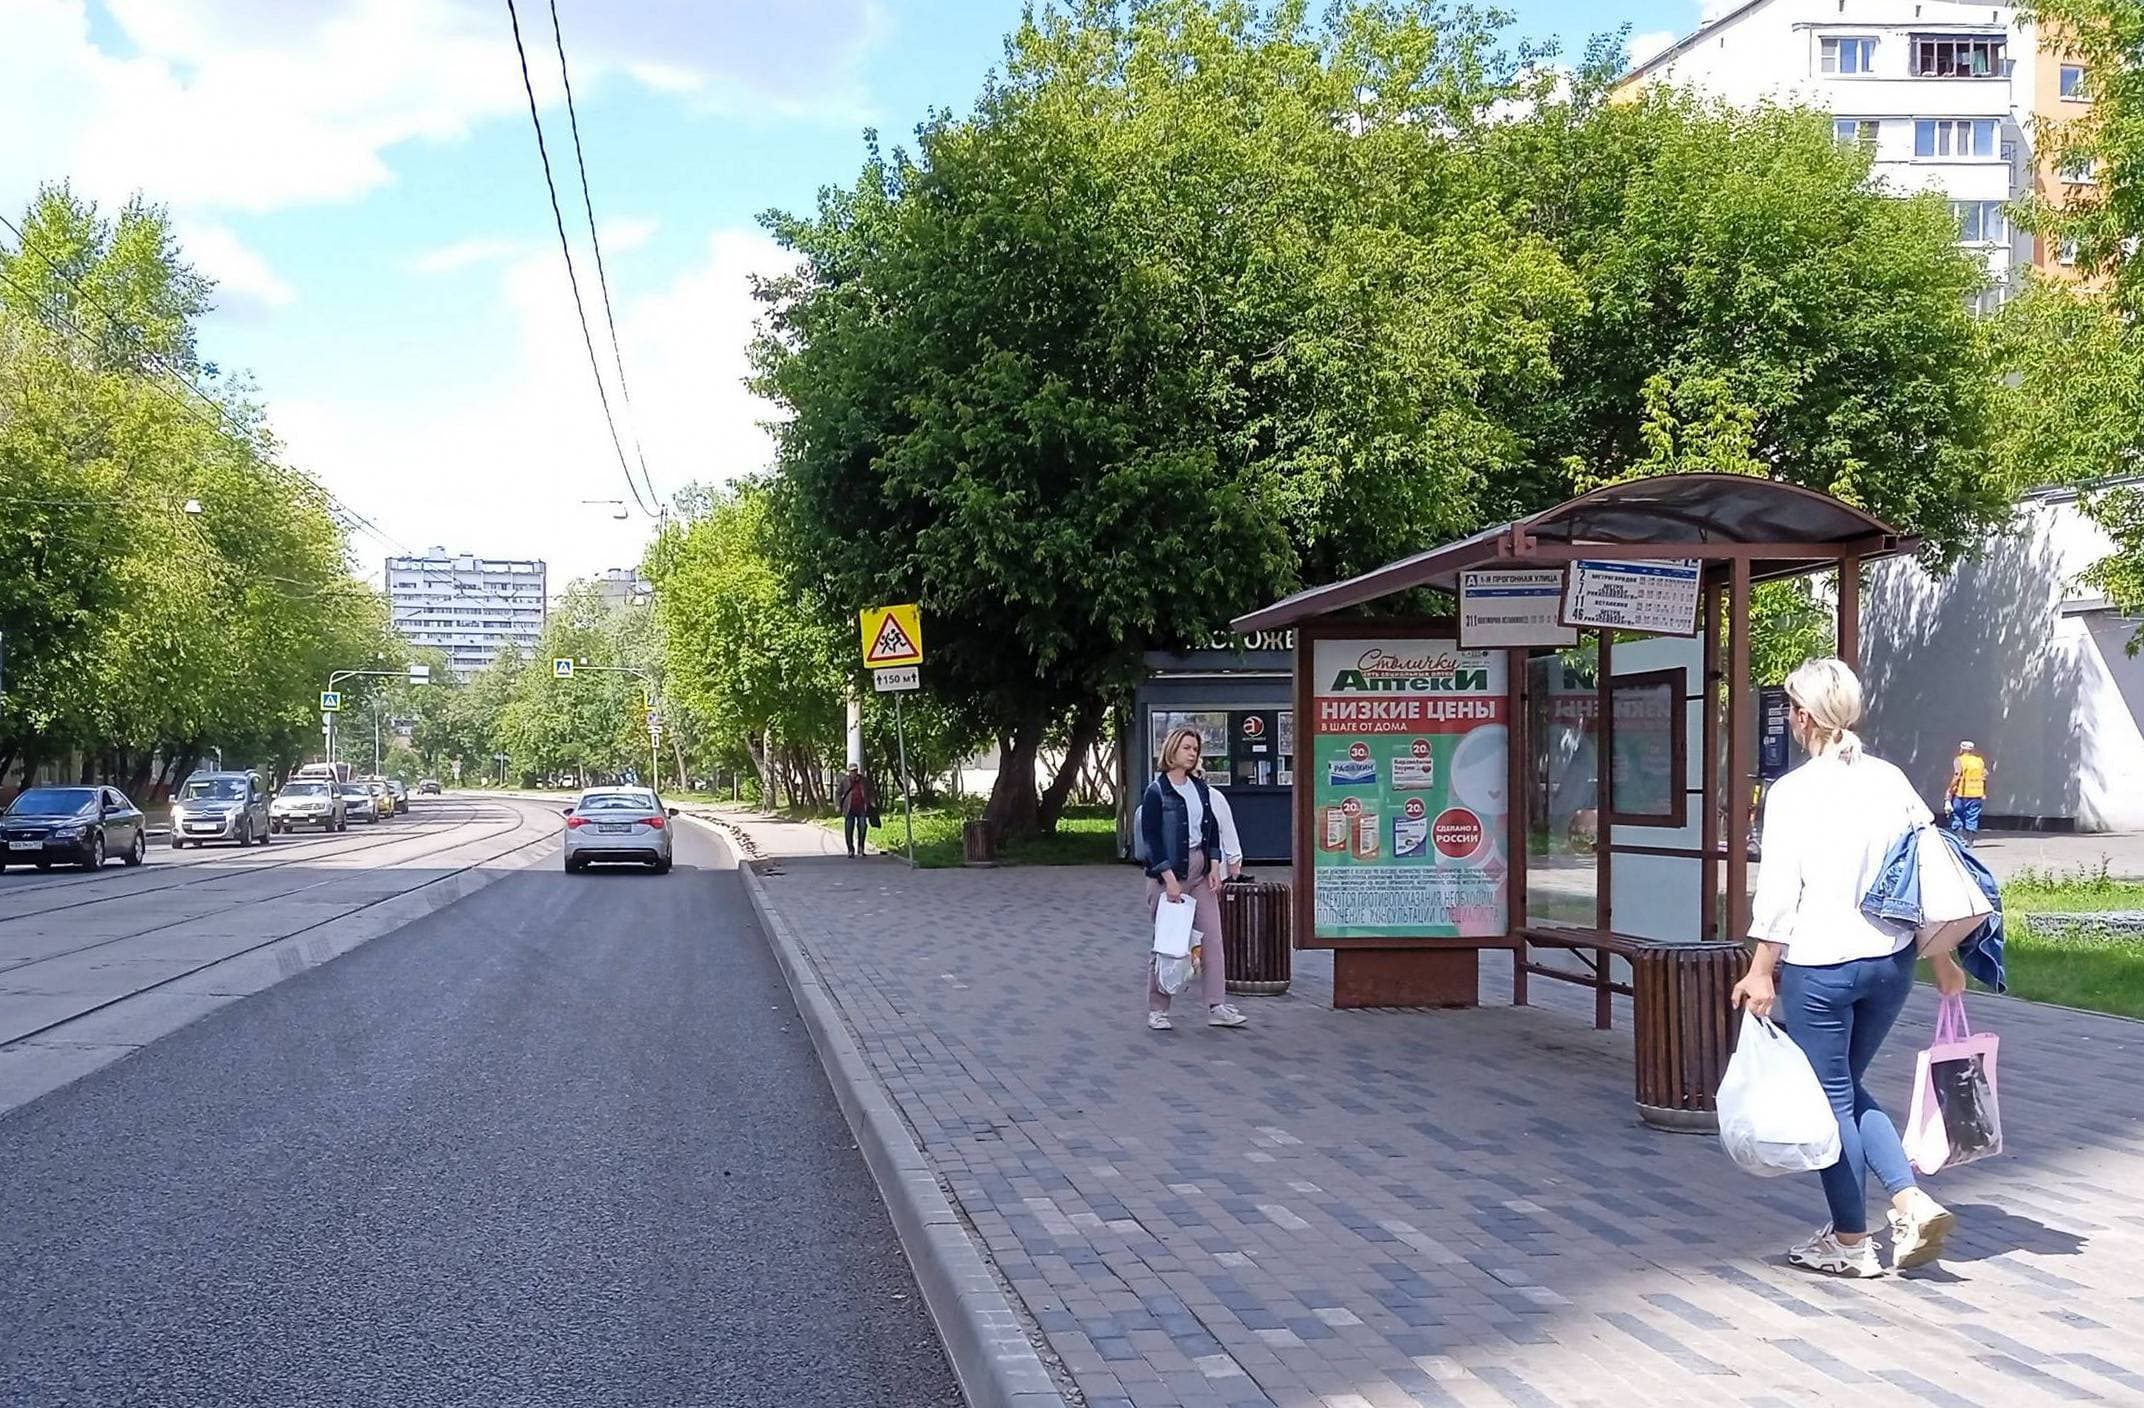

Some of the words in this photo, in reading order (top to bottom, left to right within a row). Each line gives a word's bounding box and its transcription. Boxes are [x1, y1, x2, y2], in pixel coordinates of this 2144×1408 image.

[1492, 574, 1533, 584] ПРОГОННАЯ
[1535, 574, 1558, 583] УЛИЦА
[1579, 569, 1586, 581] 2
[1578, 582, 1585, 594] 7
[1575, 595, 1585, 607] 11
[1572, 608, 1584, 621] 46
[1357, 649, 1460, 671] Столички
[883, 675, 900, 684] 150
[1321, 701, 1420, 720] НИЗКИЕ
[1427, 700, 1496, 722] ЦЕНЫ
[1321, 723, 1328, 732] В
[1330, 723, 1358, 732] ШАГЕ
[1359, 722, 1373, 732] ОТ
[1374, 722, 1408, 732] ДОМА
[1436, 825, 1472, 833] СДЕЛАНО
[1436, 834, 1479, 843] РОССИИ
